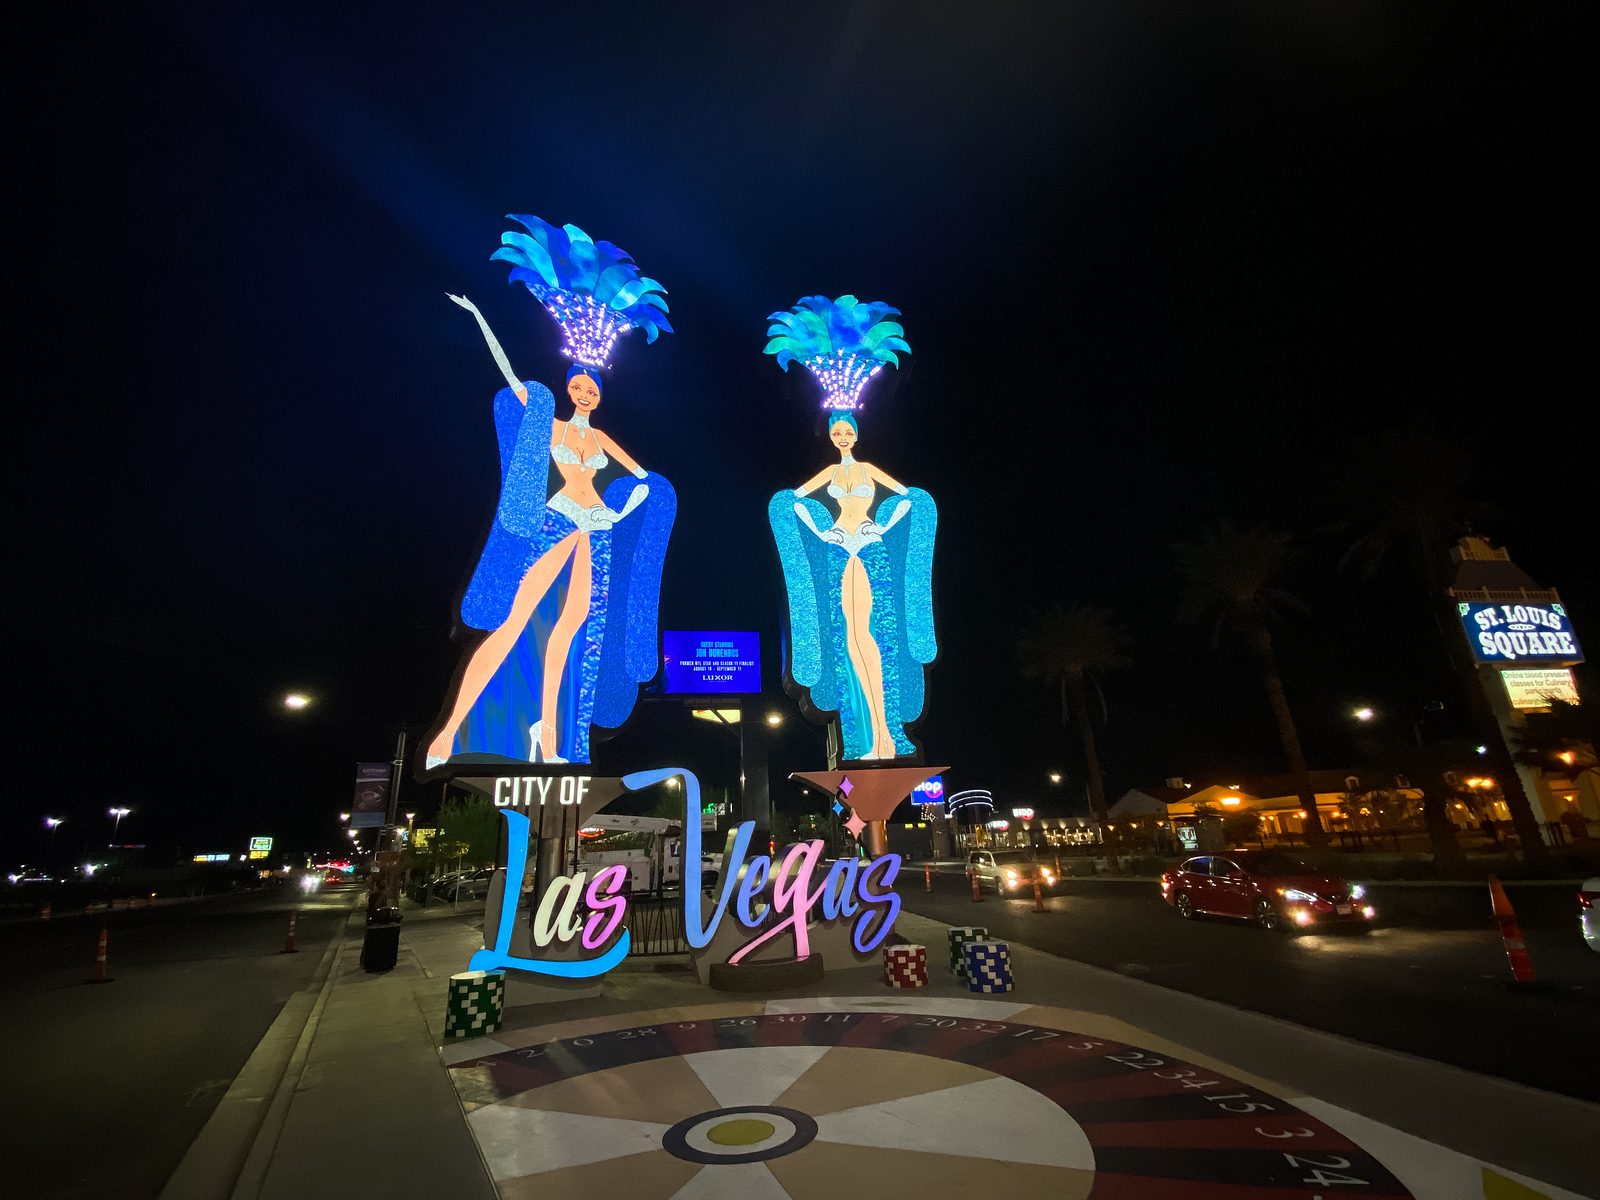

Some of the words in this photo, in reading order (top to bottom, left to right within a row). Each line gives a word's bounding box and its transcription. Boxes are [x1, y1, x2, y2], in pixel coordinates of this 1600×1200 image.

[1474, 608, 1504, 630] ST.
[1501, 605, 1562, 630] LOUIS
[1478, 632, 1577, 659] SQUARE
[696, 648, 707, 658] JON
[494, 776, 553, 807] CITY
[560, 776, 591, 806] OF
[468, 809, 630, 978] Las
[622, 767, 902, 966] Vegas
[678, 1022, 697, 1031] 9
[719, 1018, 758, 1028] 26
[769, 1015, 807, 1025] 30
[914, 1017, 957, 1028] 20
[960, 1020, 1009, 1034] 32
[1015, 1029, 1062, 1041] 17
[1067, 1041, 1104, 1052] 5
[1105, 1052, 1165, 1070] 22
[1153, 1069, 1221, 1090] 34
[1202, 1091, 1278, 1114] 15
[1254, 1126, 1316, 1140] 3
[1282, 1151, 1371, 1188] 24
